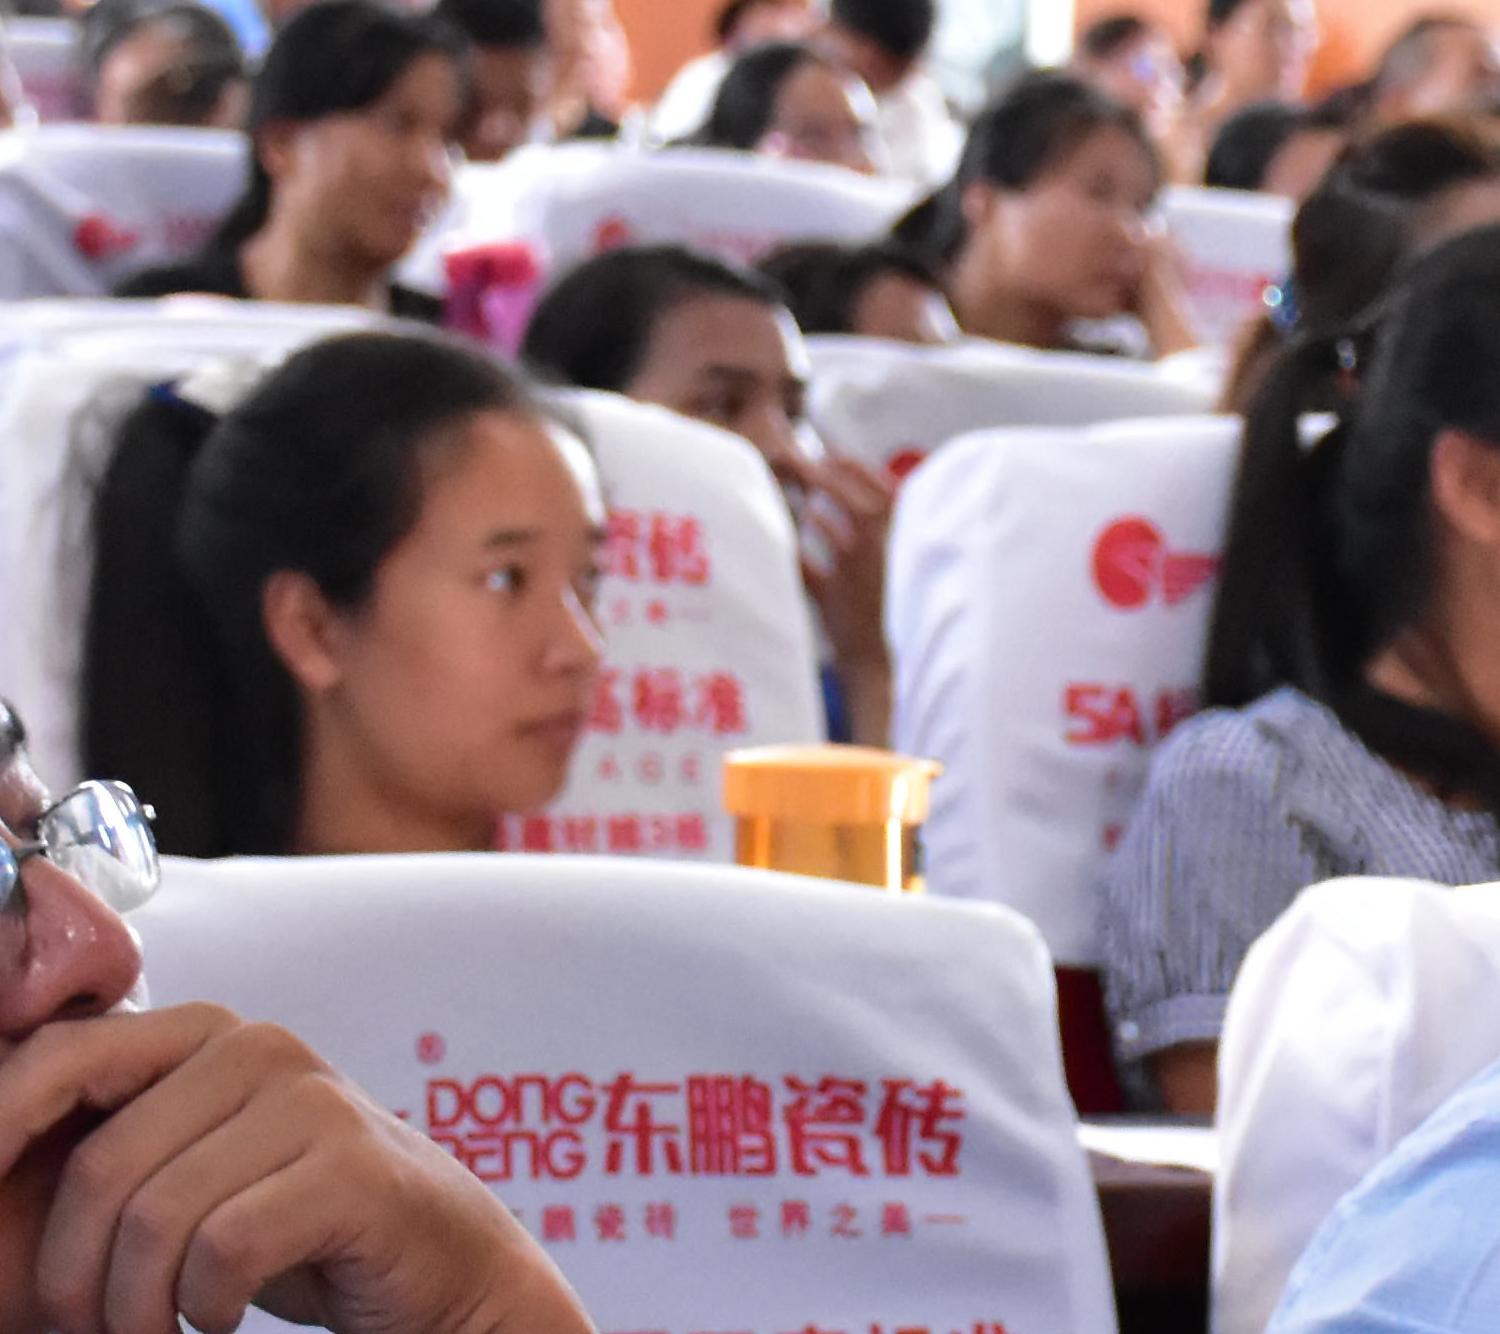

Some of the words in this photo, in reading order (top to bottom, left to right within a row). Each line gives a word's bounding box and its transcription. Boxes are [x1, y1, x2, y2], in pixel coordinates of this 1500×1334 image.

[426, 1072, 597, 1130] DONG
[602, 1071, 966, 1178] 东鹏瓷砖
